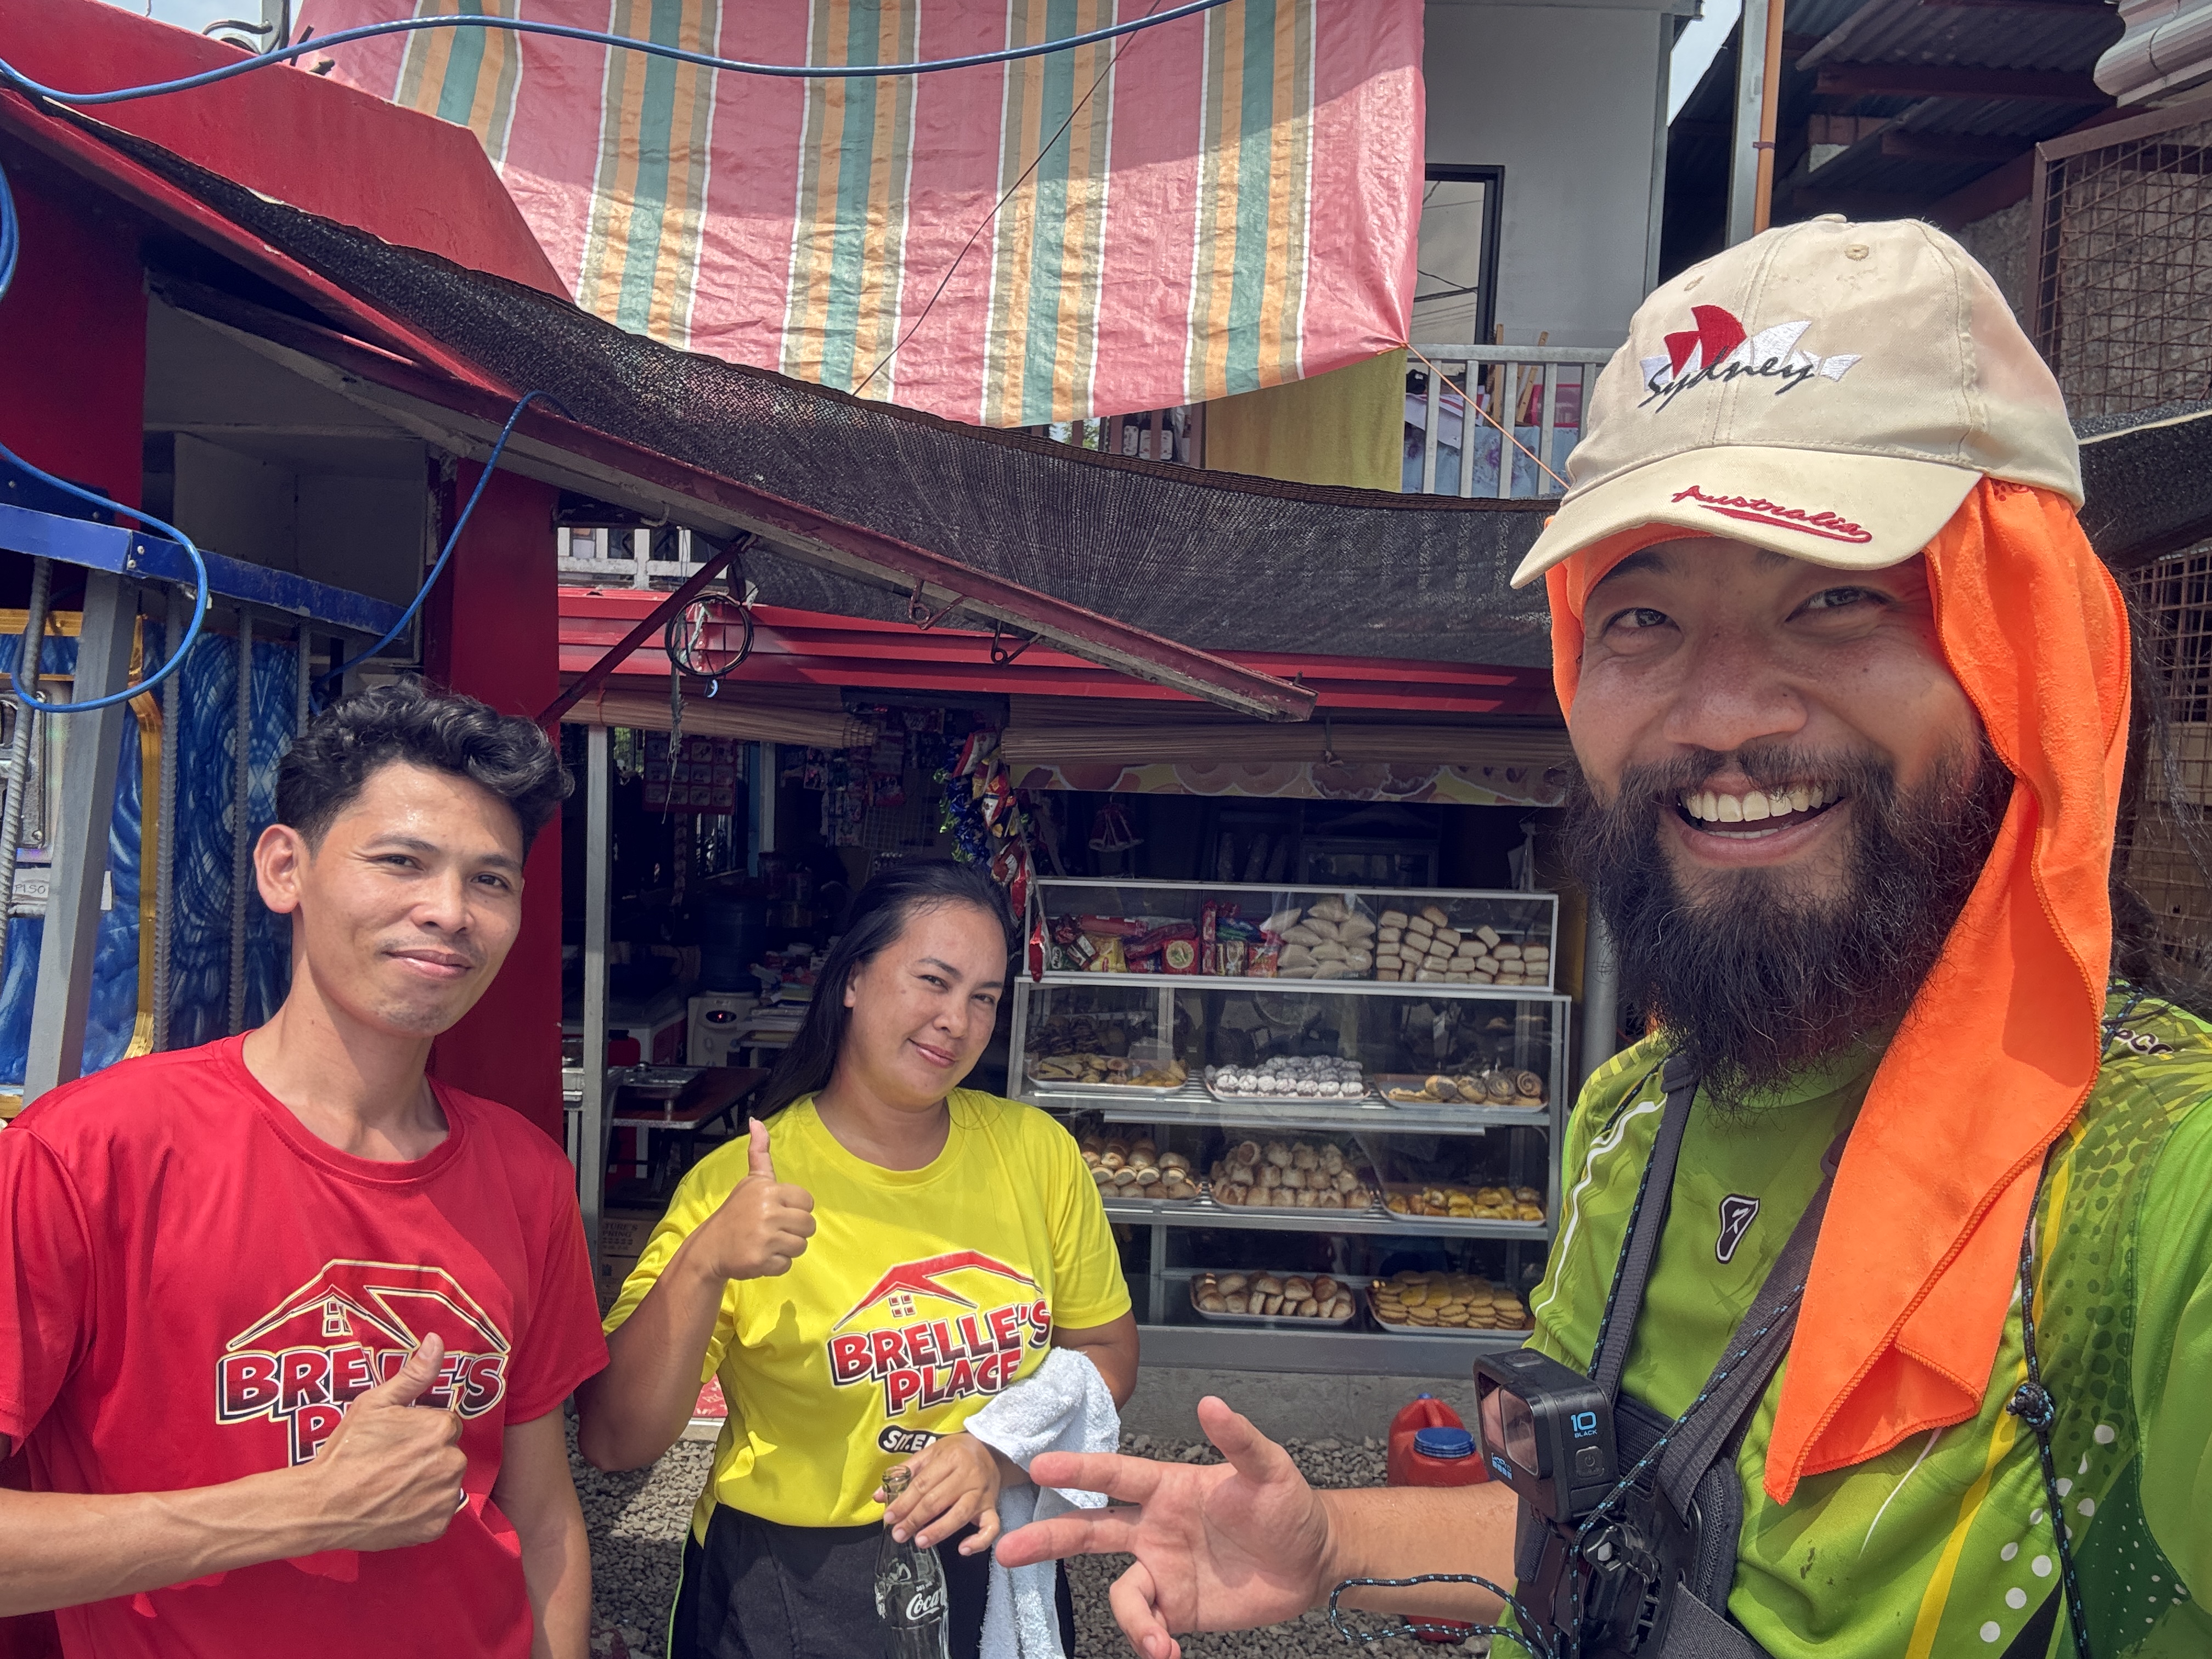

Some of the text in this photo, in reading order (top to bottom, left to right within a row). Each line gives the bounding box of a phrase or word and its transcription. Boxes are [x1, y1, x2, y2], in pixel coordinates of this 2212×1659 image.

[1638, 346, 1815, 413] Sydney
[1671, 486, 1872, 542] Australia
[14, 884, 46, 894] PISO
[828, 1298, 1052, 1386] BRELLE'S
[887, 1348, 1023, 1417] PLACE
[1570, 1412, 1596, 1432] 10
[1575, 1429, 1598, 1438] BLACK
[906, 1589, 940, 1621] Coca
